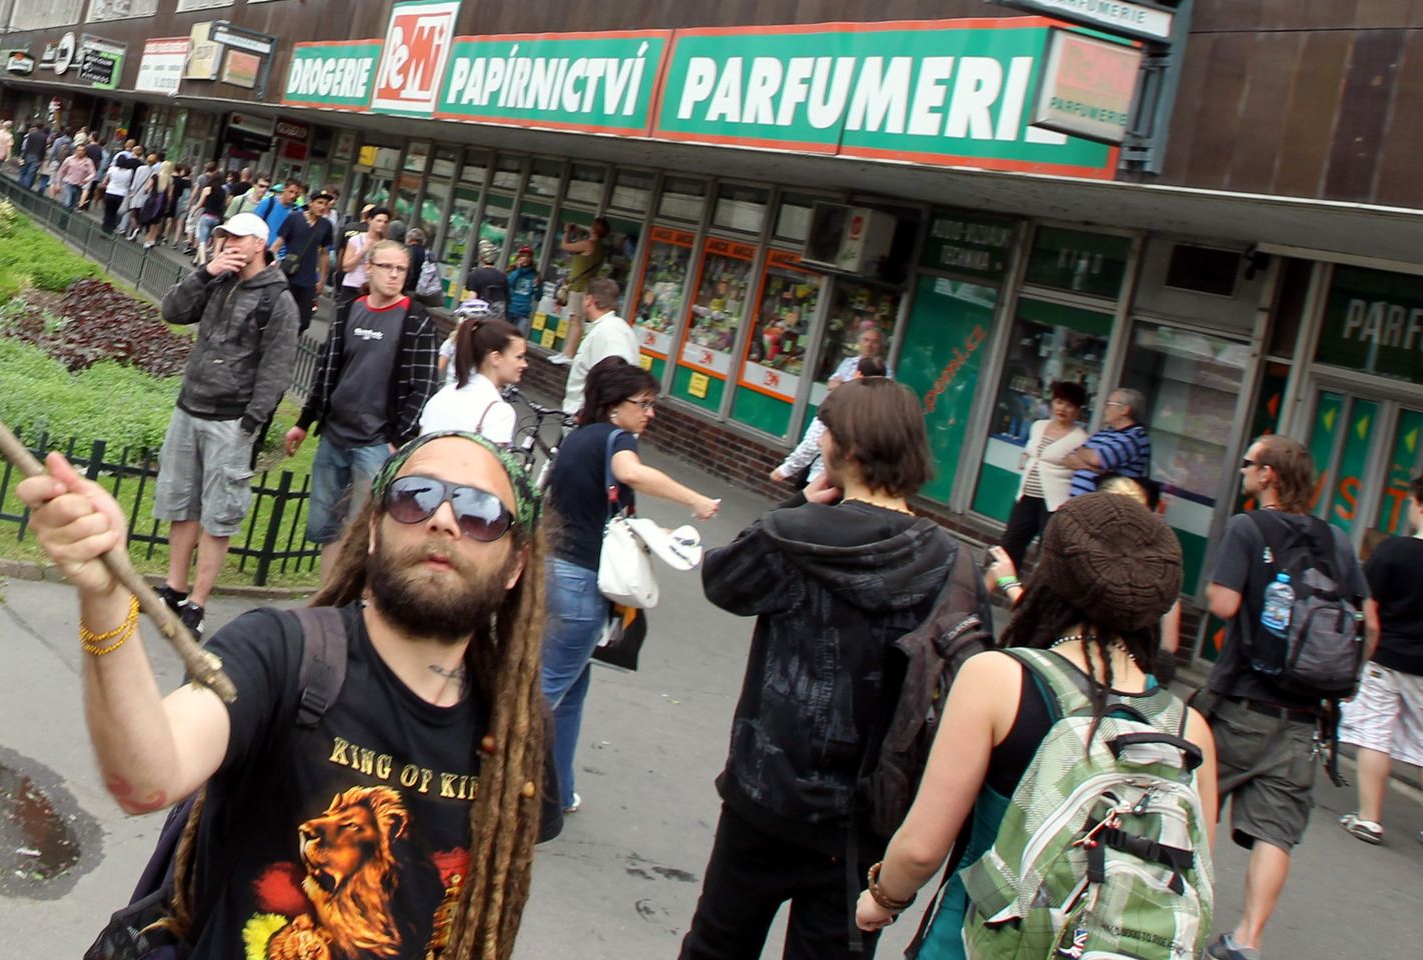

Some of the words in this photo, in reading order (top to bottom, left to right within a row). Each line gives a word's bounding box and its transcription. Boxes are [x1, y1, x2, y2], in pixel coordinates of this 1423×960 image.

[287, 57, 373, 98] DROGERIE
[446, 41, 649, 116] PAPÍRNICTVÍ
[1050, 96, 1128, 126] PARFUMERIE
[329, 736, 393, 780] KING
